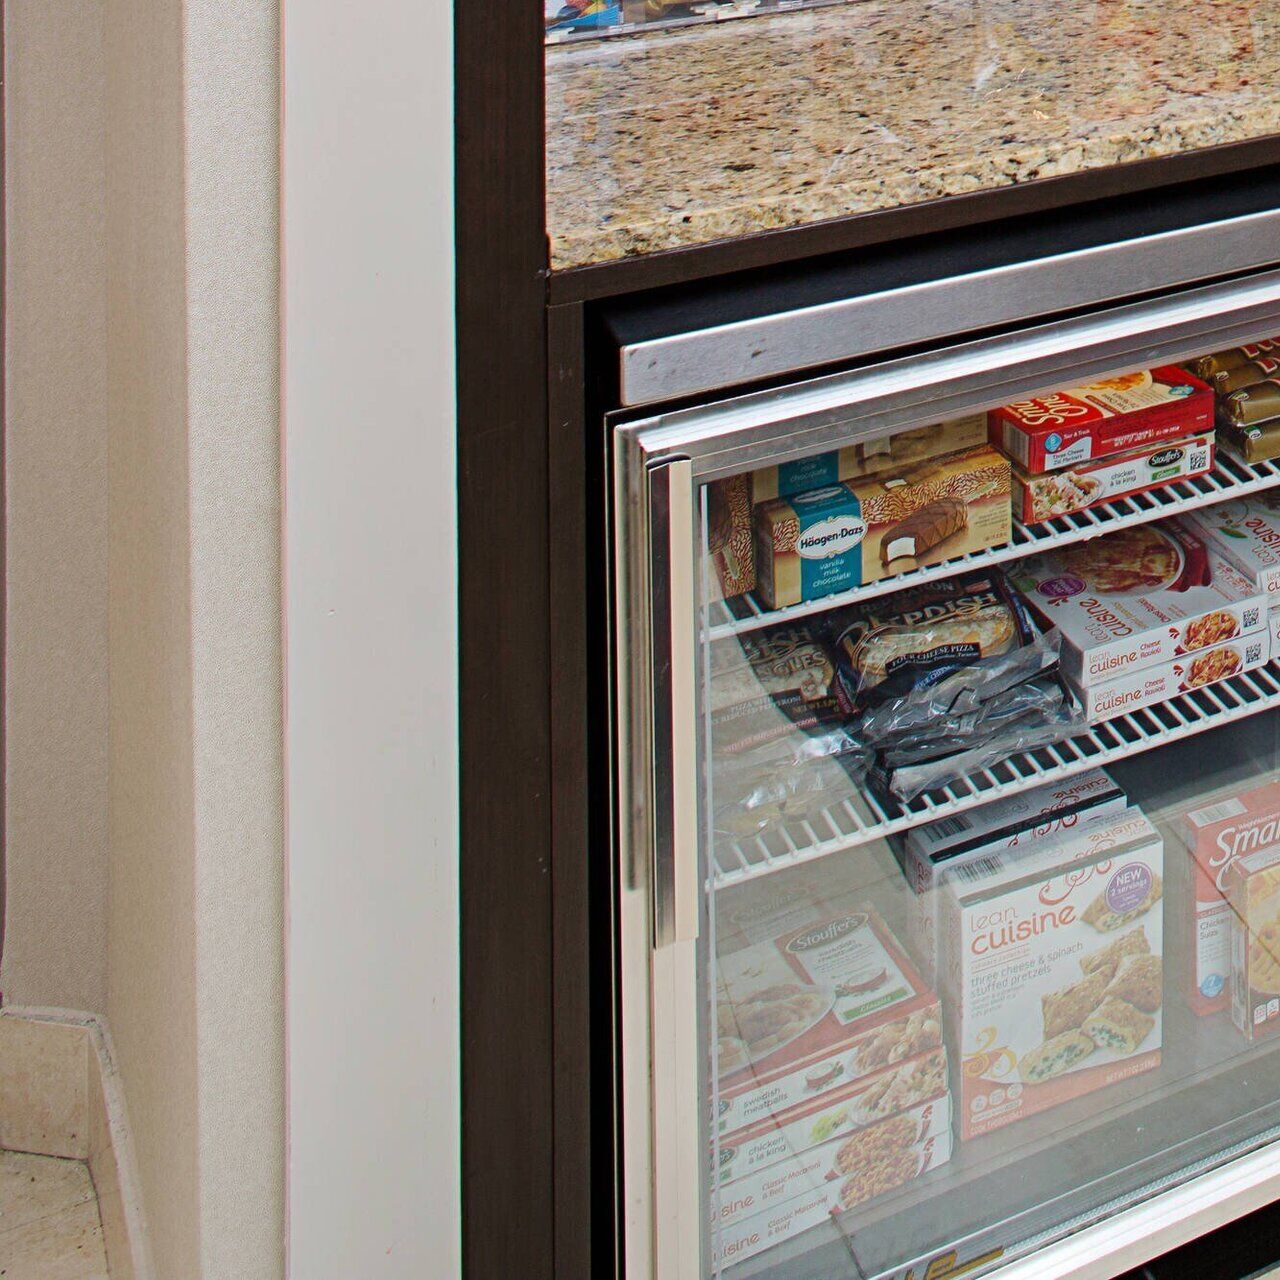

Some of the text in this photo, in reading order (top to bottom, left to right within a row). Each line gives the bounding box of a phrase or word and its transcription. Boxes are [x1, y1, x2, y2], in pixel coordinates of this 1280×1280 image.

[1110, 468, 1136, 480] chicken
[812, 571, 853, 588] chocolate
[915, 646, 950, 661] CHEESE
[950, 644, 975, 653] PIZZA
[1140, 639, 1161, 651] Cheese
[1089, 651, 1138, 675] cuisine
[1144, 677, 1165, 689] Cheese
[1094, 690, 1143, 714] cuisine
[1115, 868, 1143, 886] NEW
[970, 906, 1019, 933] lean
[970, 905, 1076, 955] cuisine
[795, 916, 862, 951] Stouffer's
[970, 941, 1084, 988] three cheese & spinach
[970, 967, 1052, 1000] stuffed pretzels
[748, 1136, 785, 1156] chicken
